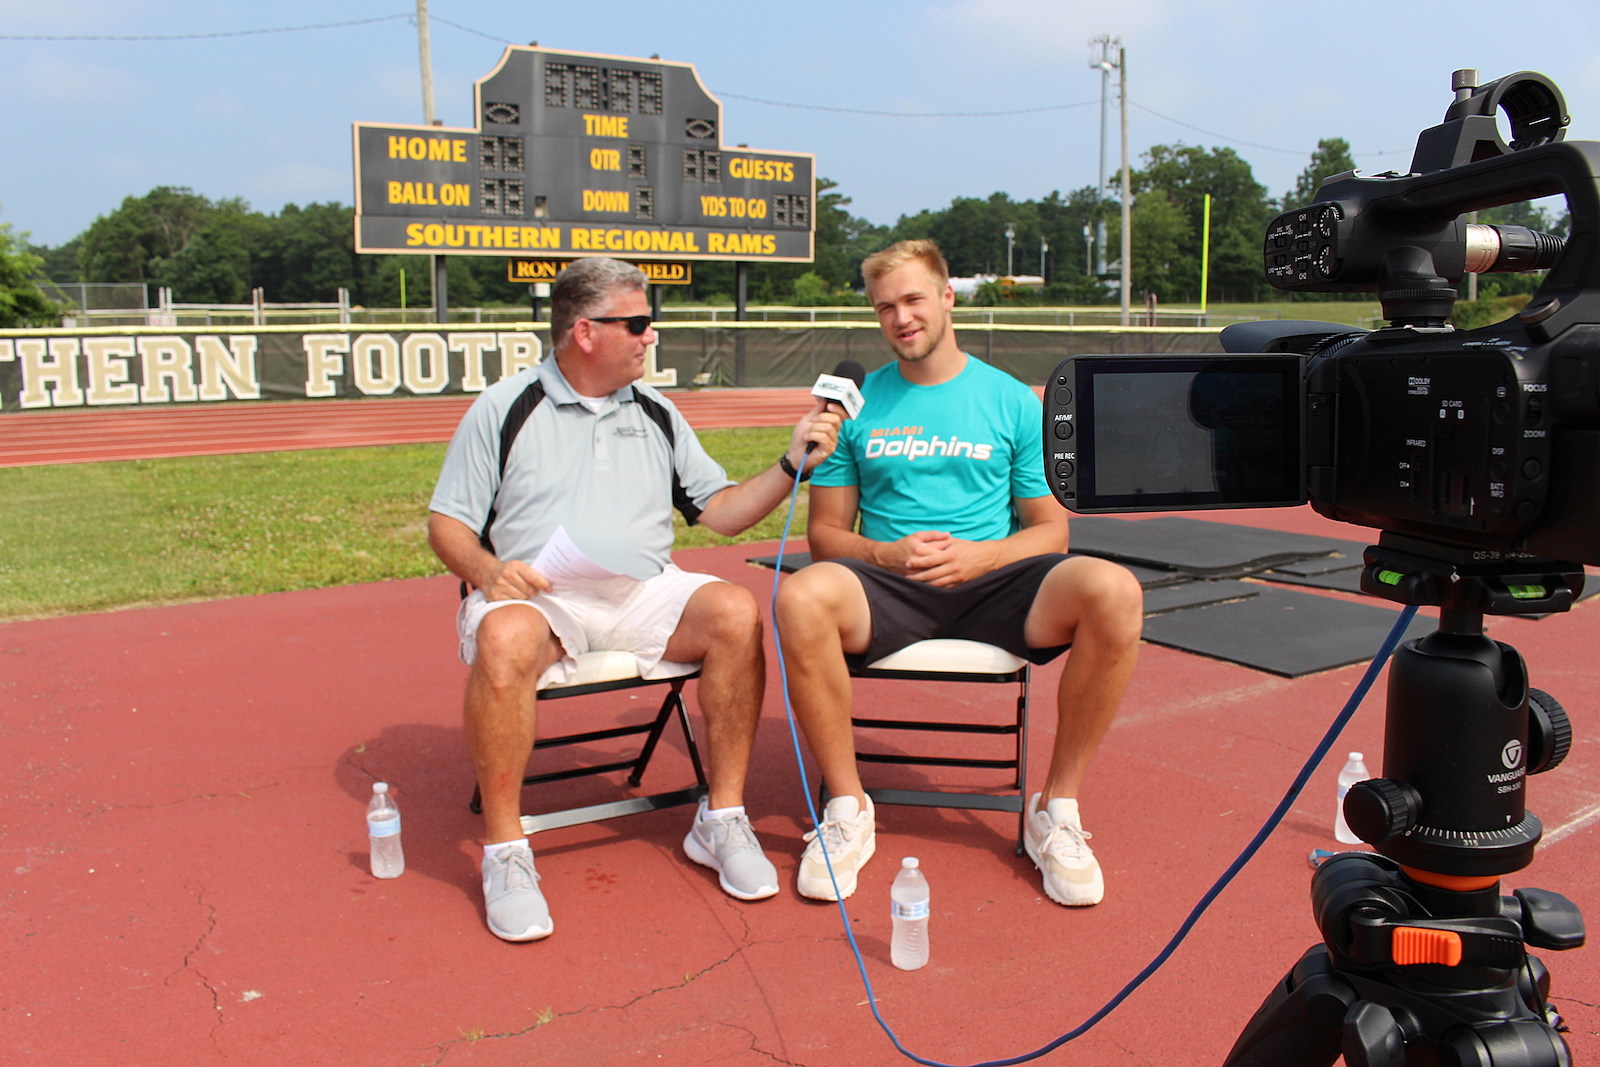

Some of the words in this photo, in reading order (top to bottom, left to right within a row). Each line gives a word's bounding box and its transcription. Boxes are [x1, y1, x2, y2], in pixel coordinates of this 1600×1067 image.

[583, 114, 629, 139] TIME
[388, 136, 467, 163] HOME
[590, 148, 621, 171] QTR
[729, 158, 794, 183] GUESTS
[388, 181, 437, 206] BALL
[440, 183, 470, 207] ON
[582, 190, 629, 213] DOWN
[700, 195, 727, 217] YDS
[729, 196, 745, 218] TO
[746, 198, 767, 219] GO
[406, 223, 560, 249] SOUTHERN
[571, 228, 699, 253] REGIONAL
[707, 234, 776, 255] RAMS
[516, 261, 556, 277] RON
[0, 333, 260, 408] HERN
[303, 332, 678, 393] FOOTBL
[1415, 377, 1430, 385] DOLBY
[1523, 384, 1547, 392] FOCUS
[1449, 400, 1462, 408] CARD
[871, 426, 924, 438] MIAMI
[1406, 439, 1426, 447] INFRARED
[1523, 430, 1546, 438] ZOOM
[865, 436, 993, 461] Dolphins
[1473, 551, 1500, 560] QS-39
[1463, 839, 1479, 847] 315
